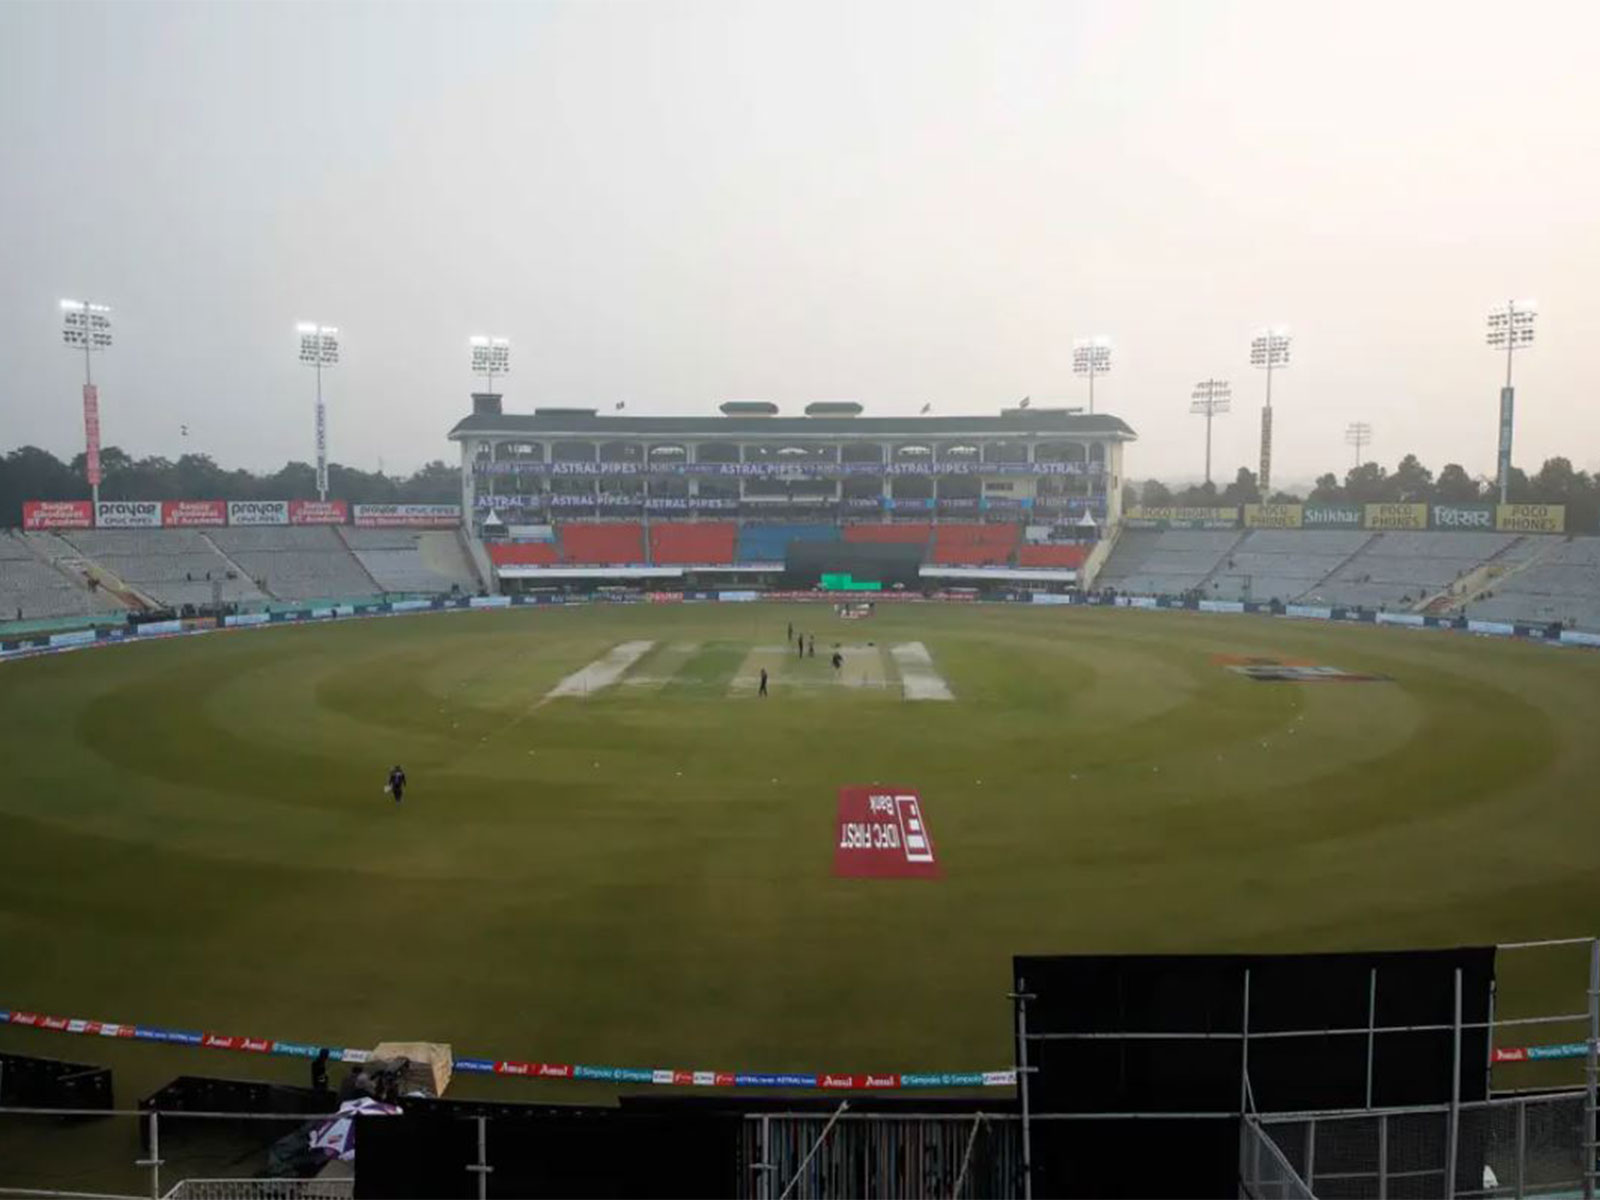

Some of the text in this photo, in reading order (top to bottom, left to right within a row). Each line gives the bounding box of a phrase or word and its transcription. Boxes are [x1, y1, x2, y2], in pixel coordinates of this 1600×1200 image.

[552, 463, 599, 473] ASTRAL
[601, 463, 637, 473] PIPES
[720, 464, 764, 475] ASTRAL
[885, 463, 930, 474] ASTRAL
[932, 463, 969, 473] PIPES
[1032, 463, 1083, 474] ASTRAL
[478, 496, 524, 507] ASTRAL
[551, 495, 595, 505] ASTRAL
[644, 499, 722, 509] ASTRAL PIPES
[1305, 508, 1359, 523] Shikhar
[1511, 506, 1549, 517] POCO
[1503, 518, 1557, 529] PHONES
[840, 823, 872, 849] FIRST
[205, 1035, 233, 1047] Amul
[240, 1038, 268, 1051] Amul
[499, 1061, 528, 1074] Amul
[540, 1063, 568, 1076] Amul
[822, 1075, 854, 1087] Amul
[864, 1075, 894, 1087] Amul
